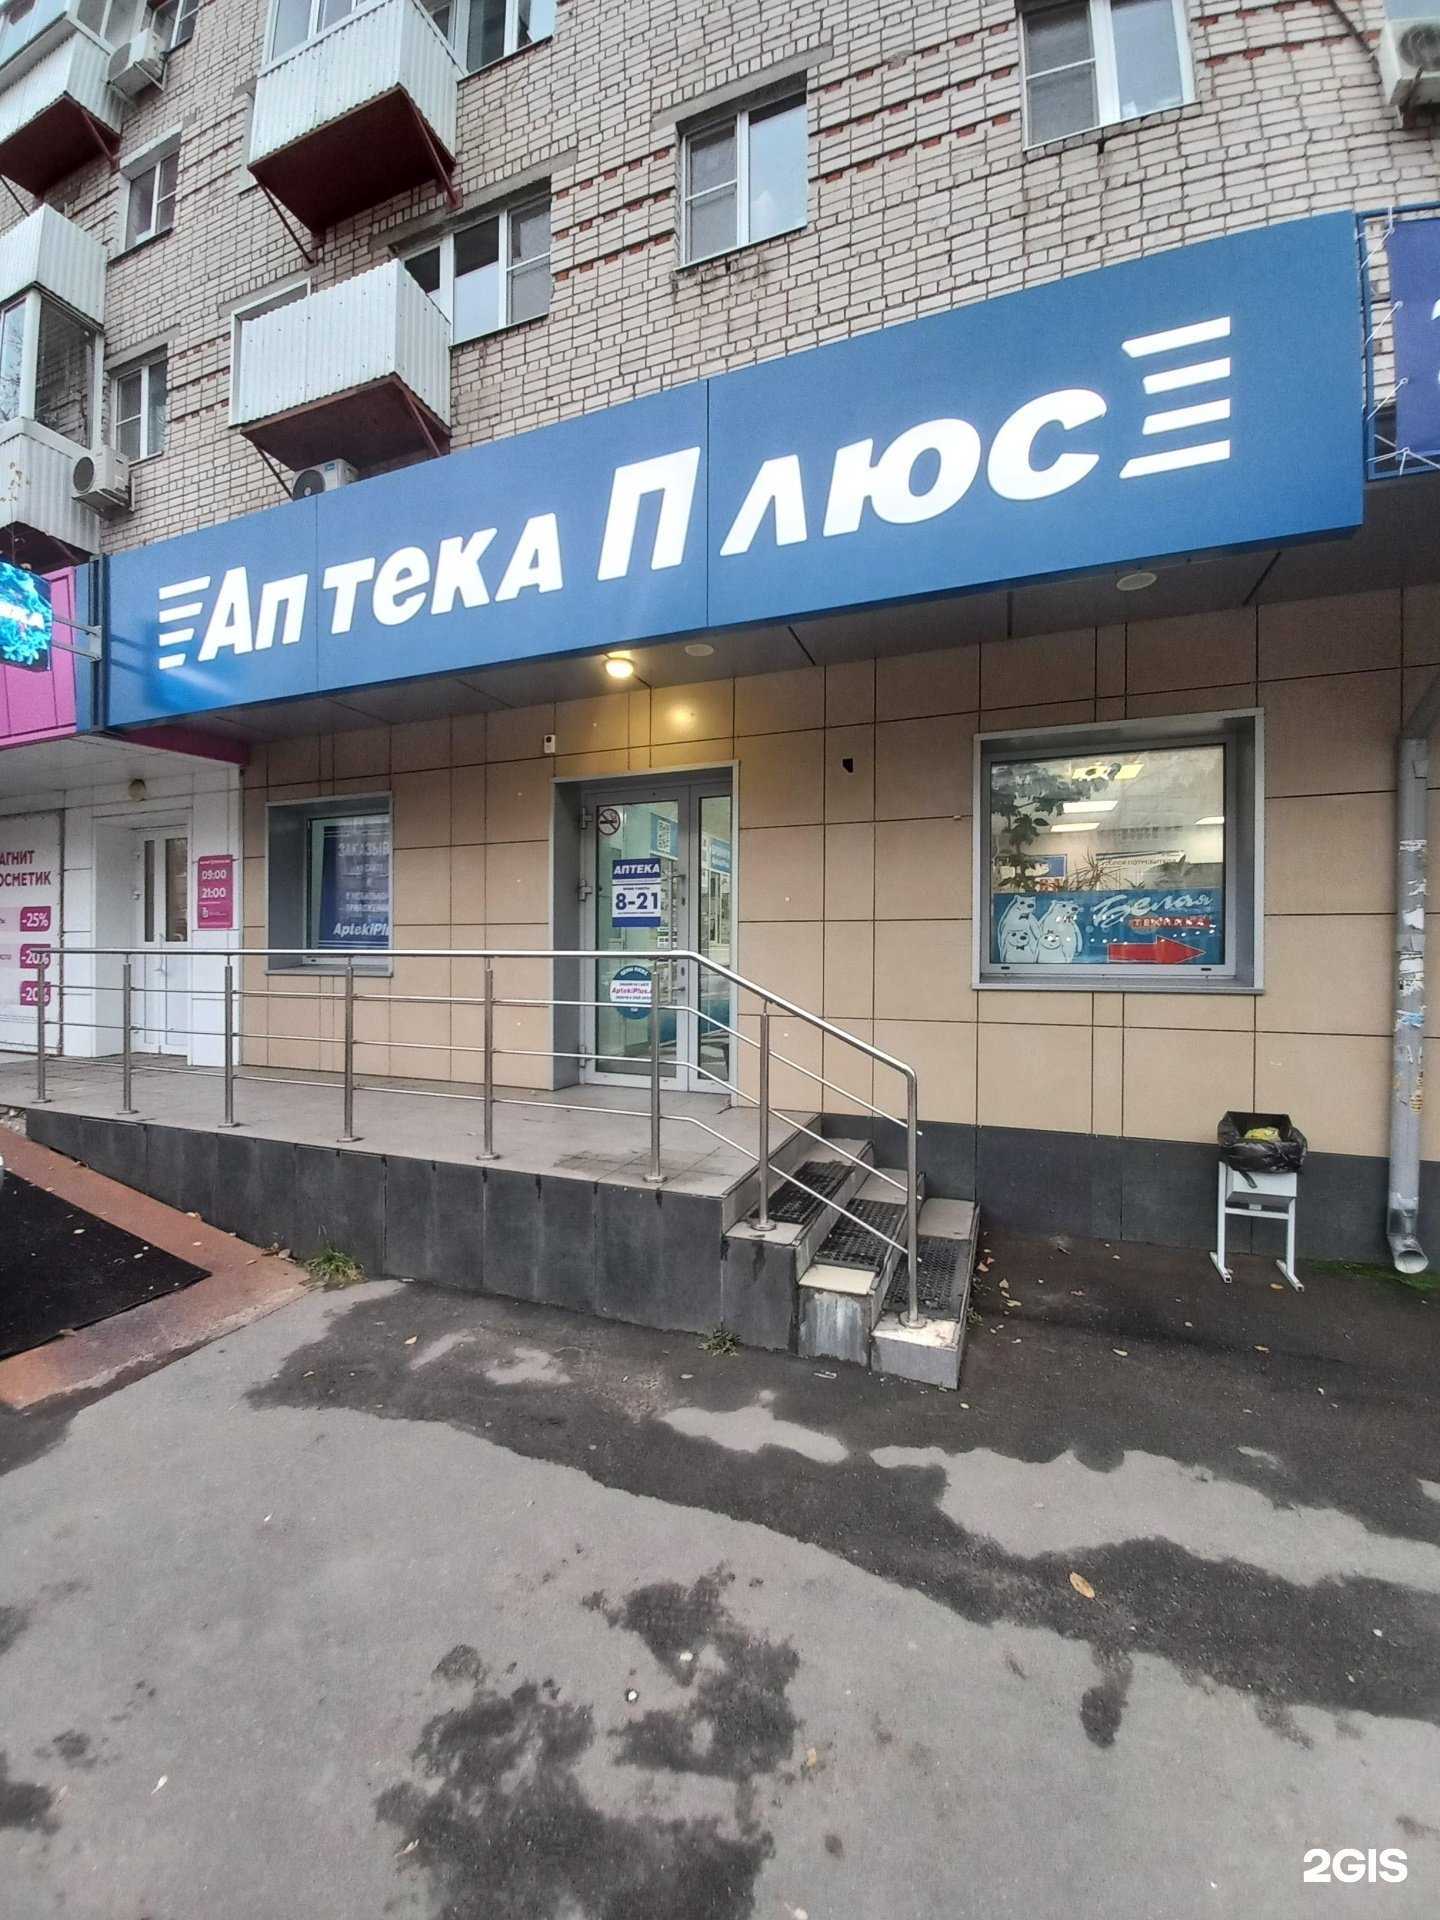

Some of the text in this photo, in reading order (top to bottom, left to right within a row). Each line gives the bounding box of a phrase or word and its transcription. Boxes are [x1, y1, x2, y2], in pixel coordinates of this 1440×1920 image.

[198, 387, 1108, 662] Аптека Плюс
[202, 869, 227, 880] 09:00
[613, 864, 660, 874] АПТЕКА
[202, 887, 226, 898] 21:00
[615, 892, 658, 910] 8-21
[21, 913, 49, 927] -25%
